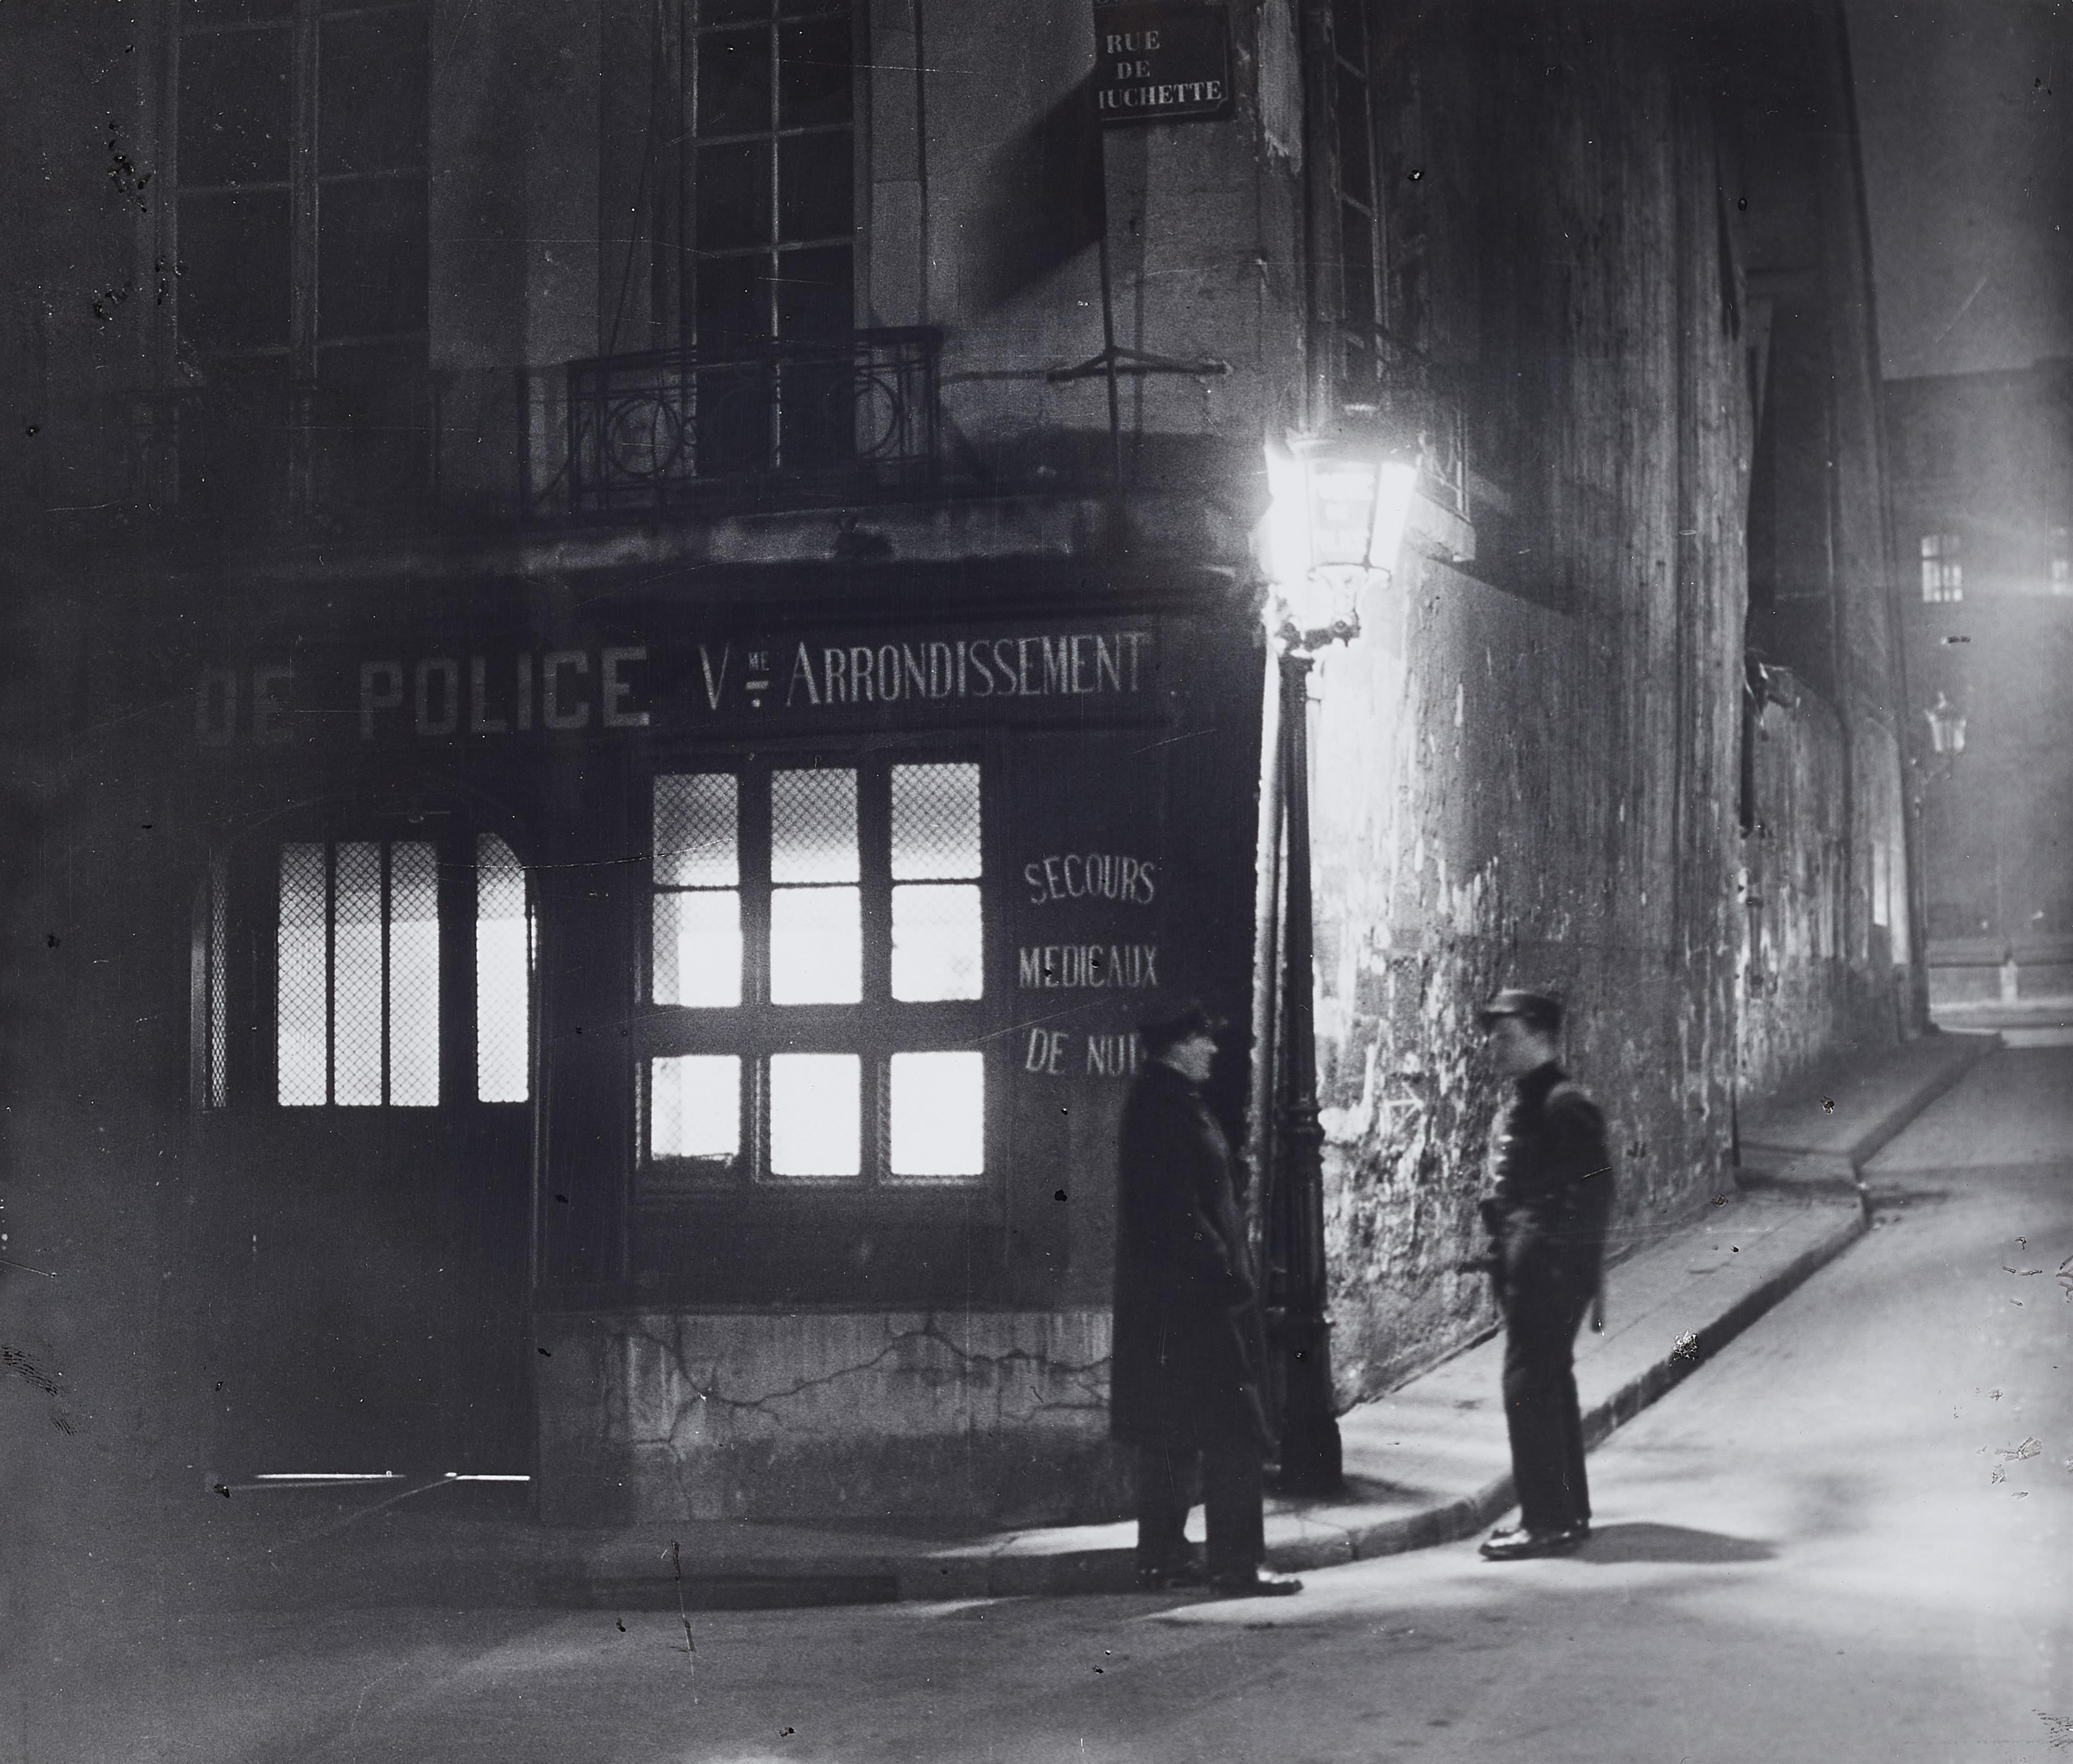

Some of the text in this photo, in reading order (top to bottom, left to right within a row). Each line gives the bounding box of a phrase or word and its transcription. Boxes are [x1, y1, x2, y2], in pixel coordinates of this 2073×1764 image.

[1106, 31, 1160, 54] RUE
[1117, 60, 1150, 79] DE
[785, 631, 1147, 708] ARRONDISSEMENT
[194, 646, 650, 746] DE POLICE
[1024, 853, 1155, 905] SECOURS
[1019, 944, 1158, 987] MEDICAUX
[1024, 1027, 1143, 1077] DE NUI
